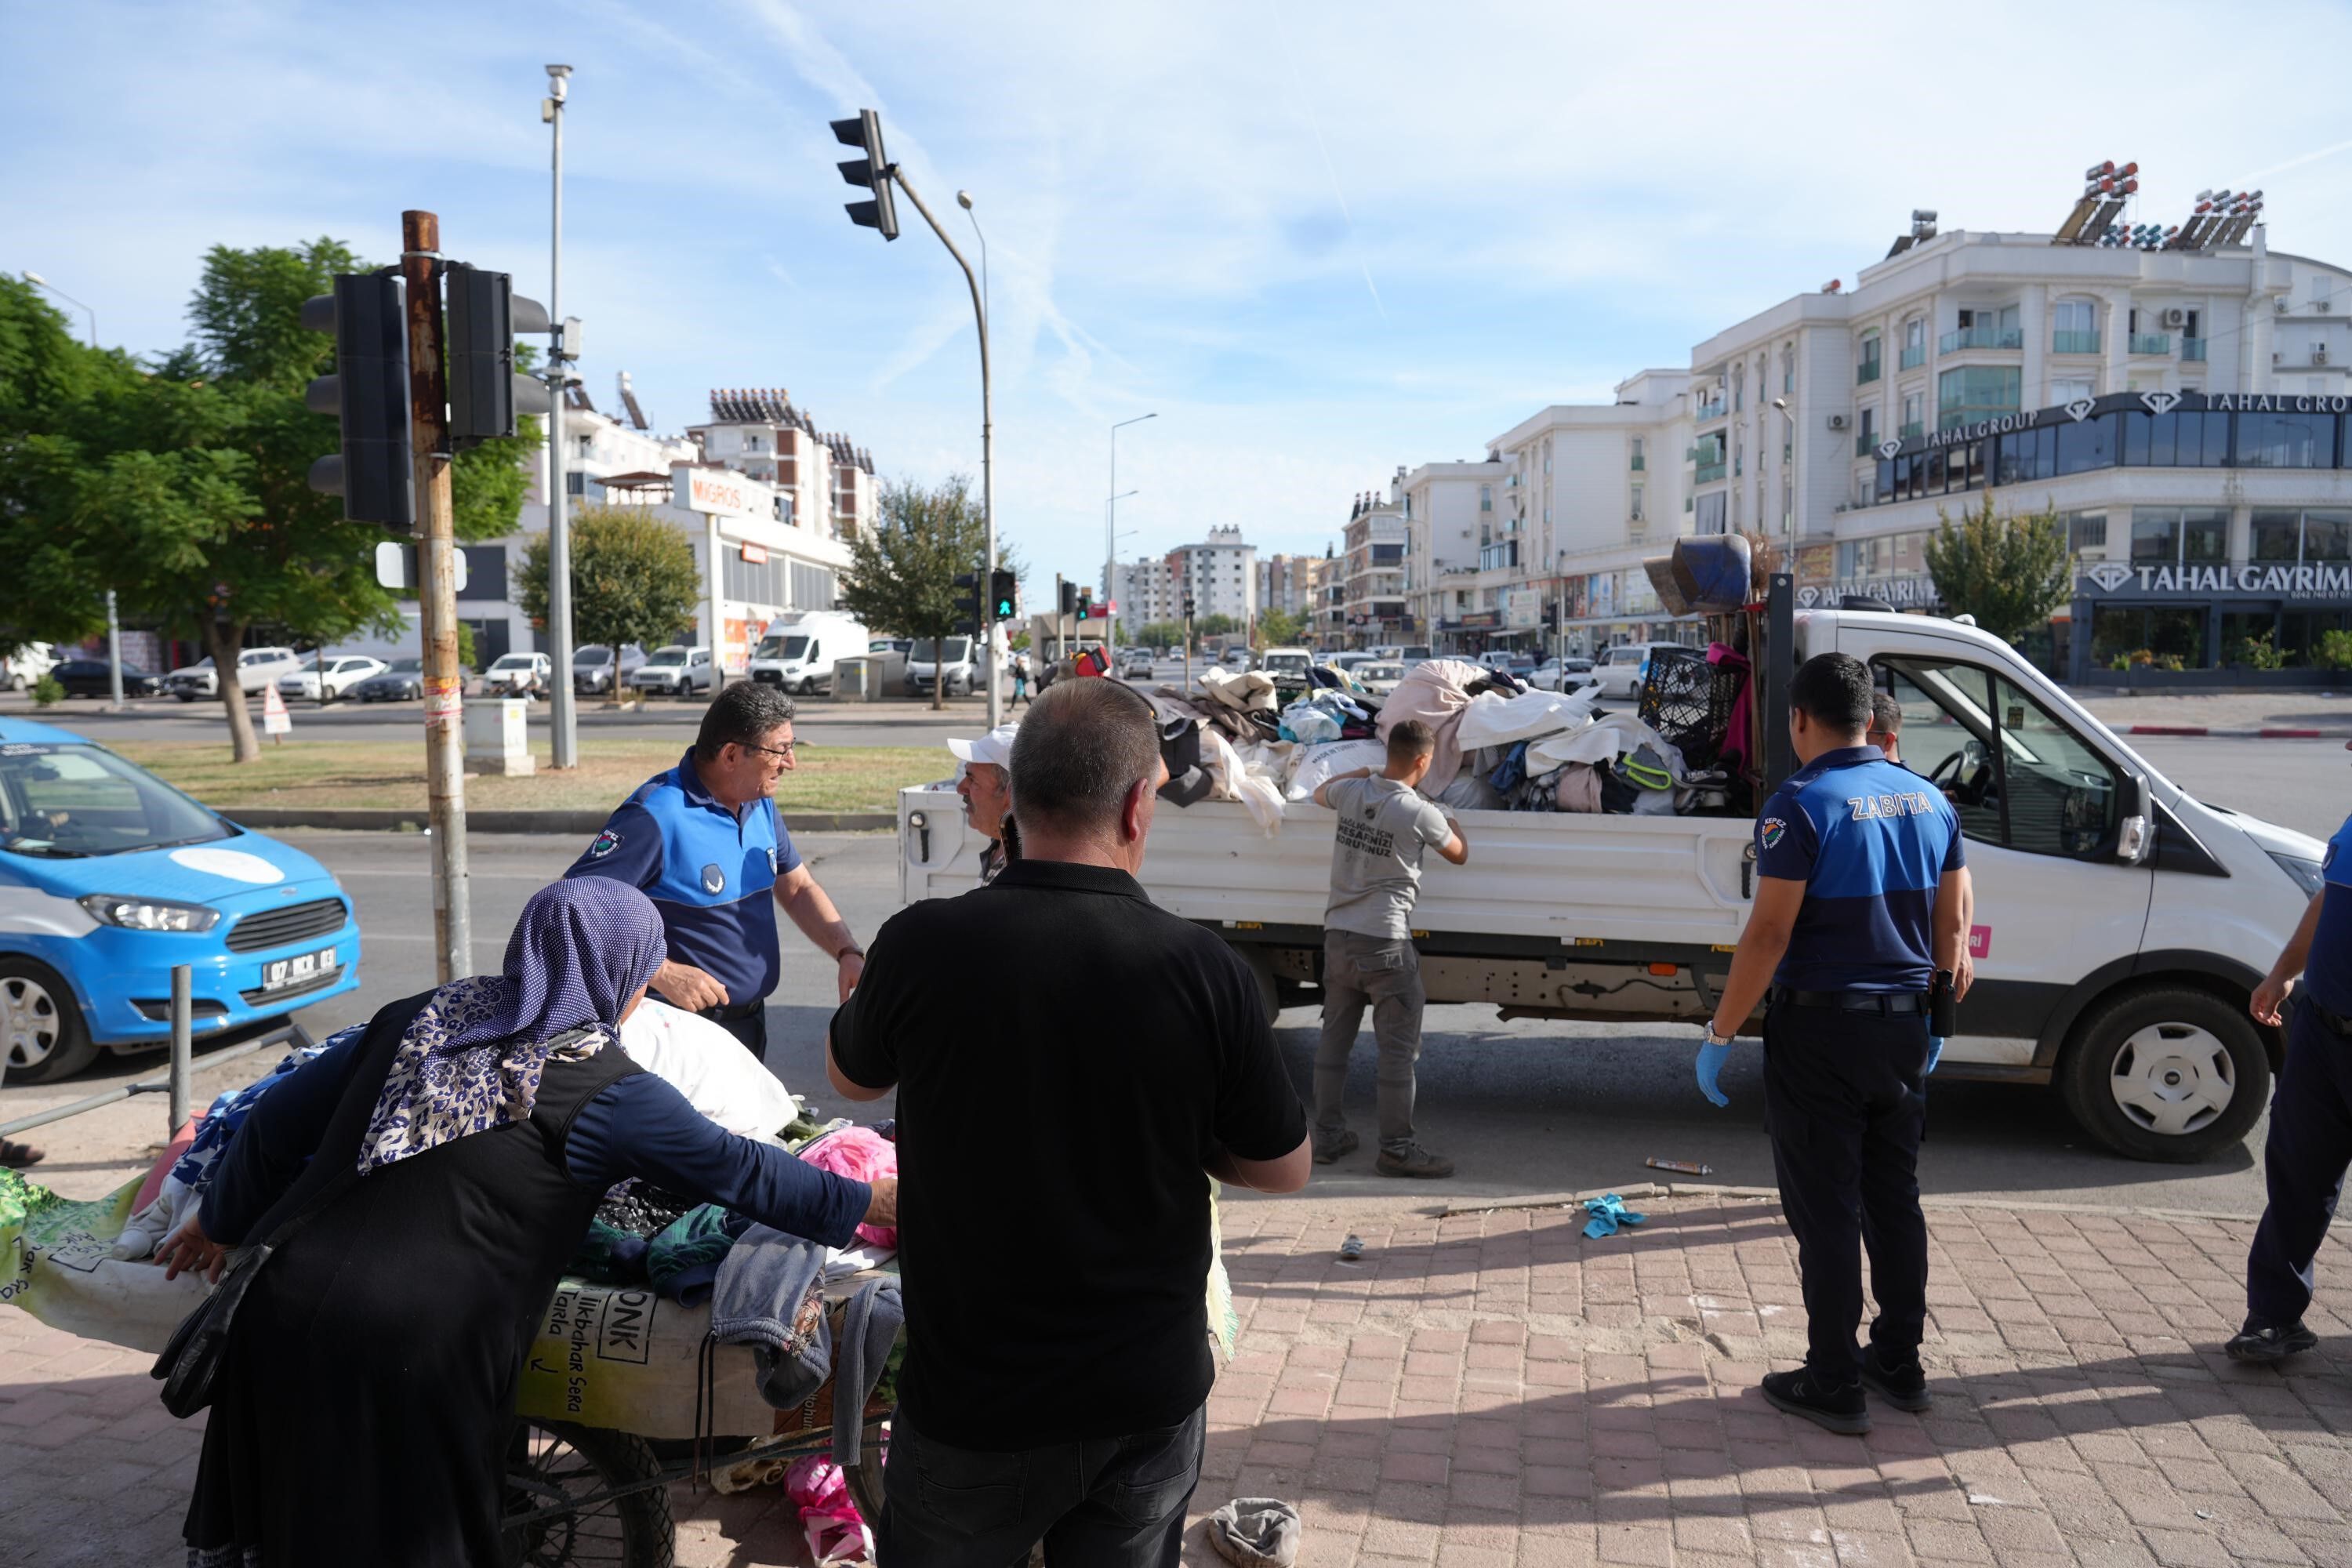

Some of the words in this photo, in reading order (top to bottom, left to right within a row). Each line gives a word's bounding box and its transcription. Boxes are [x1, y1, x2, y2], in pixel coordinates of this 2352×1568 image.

[2203, 394, 2285, 411] TAHAL
[1923, 425, 1973, 448] TAHAL
[1976, 409, 2038, 437] GROUP
[2136, 565, 2234, 590] TAHAL
[2237, 561, 2352, 591] GAYRİM
[1847, 791, 1933, 821] ZABITA
[1764, 817, 1787, 829] KEPEZ
[270, 960, 288, 982] 07
